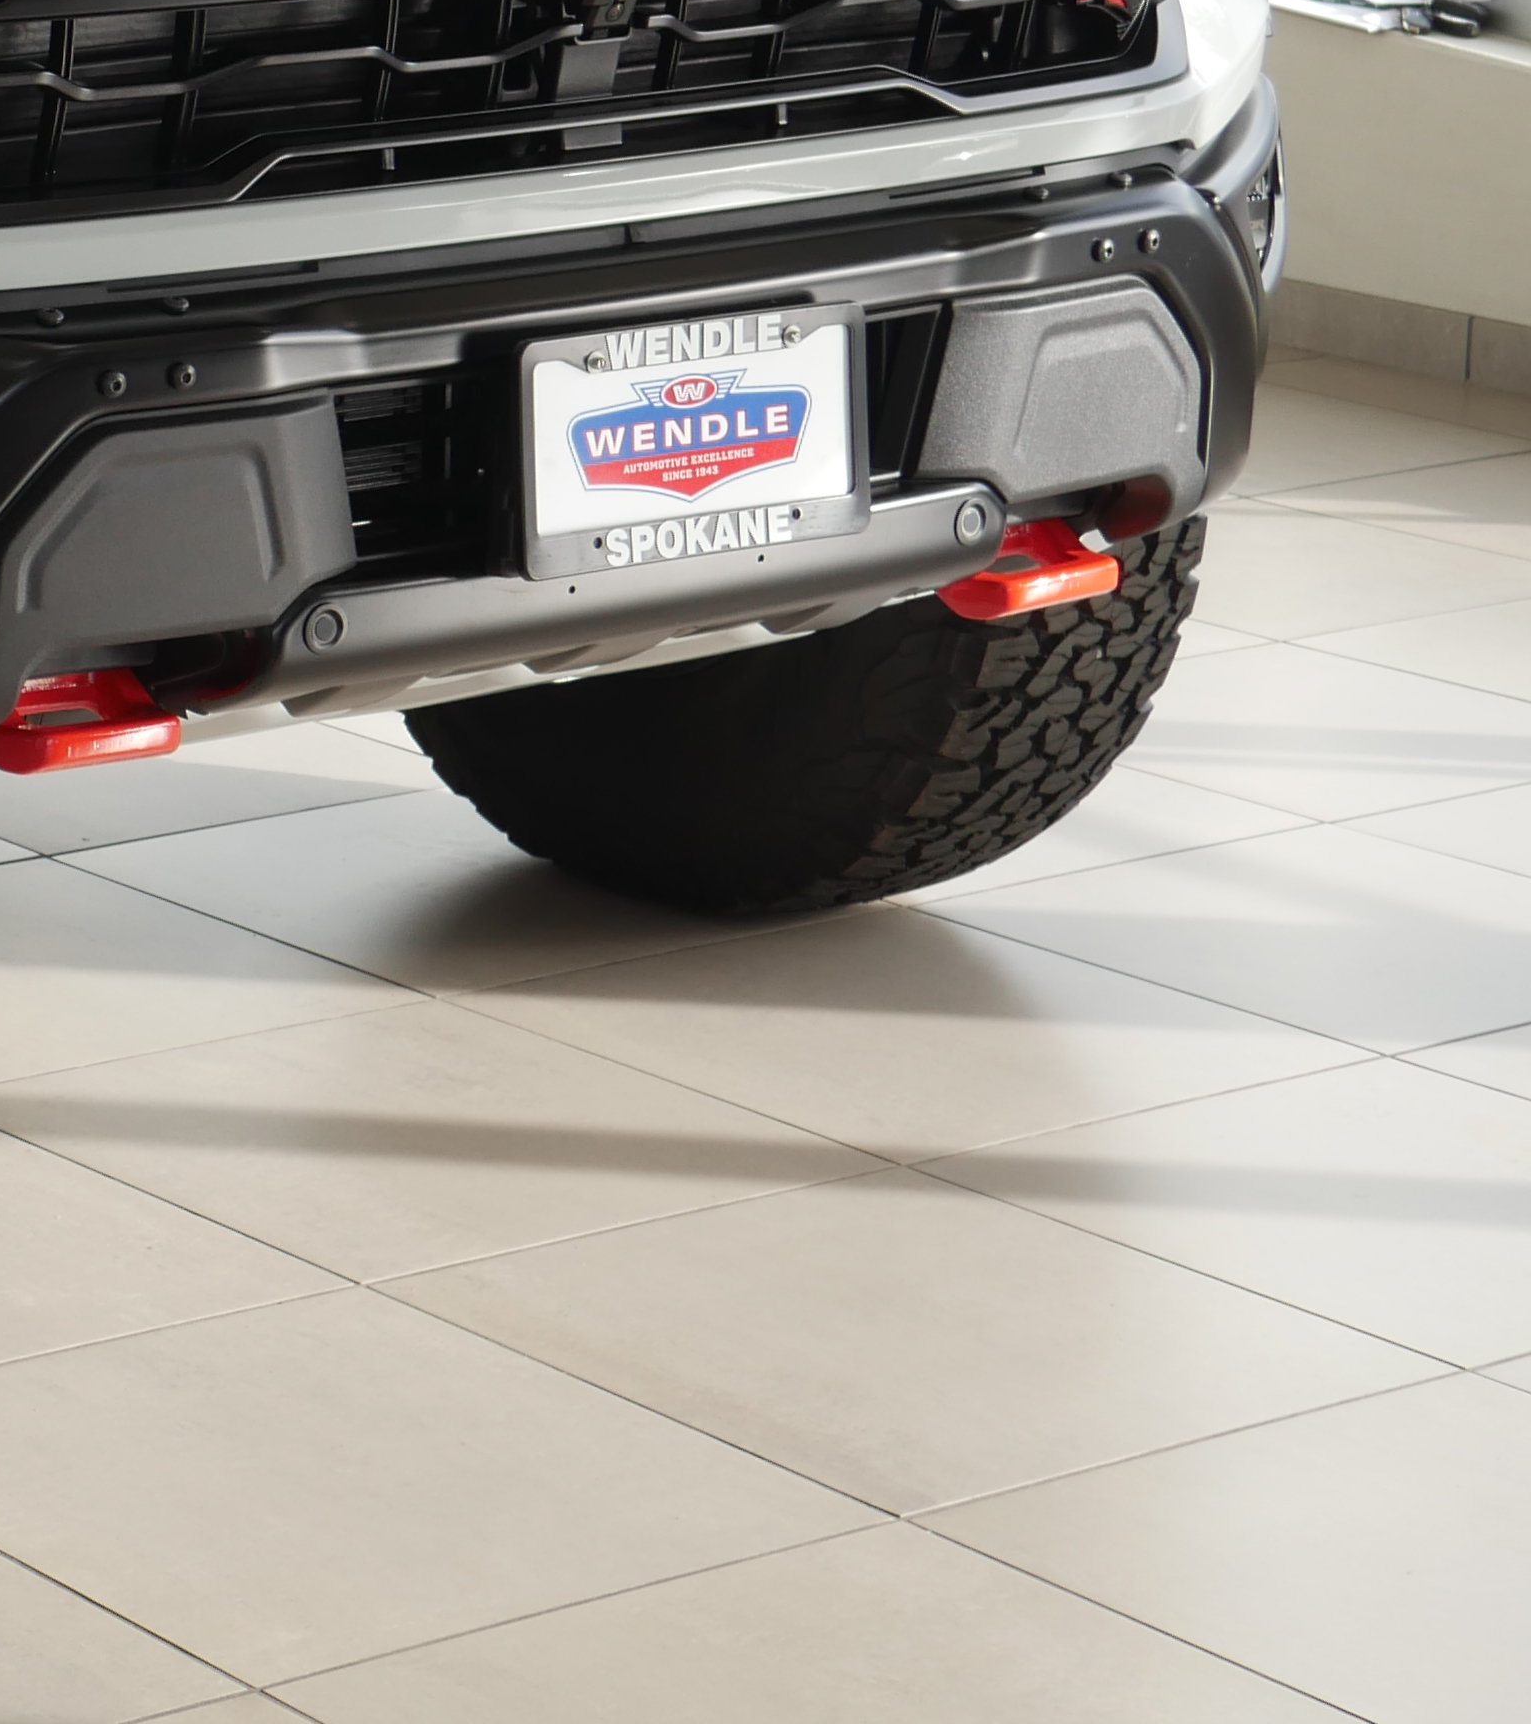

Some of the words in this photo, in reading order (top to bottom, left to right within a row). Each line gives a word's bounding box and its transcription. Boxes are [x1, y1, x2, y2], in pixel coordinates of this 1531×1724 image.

[606, 314, 782, 369] WENDLE
[585, 403, 790, 458] WENDLE
[623, 456, 688, 475] AUTOMOTIVE
[691, 447, 755, 466] EXCELLENCE
[662, 469, 693, 483] SINCE
[695, 465, 720, 479] 1943
[606, 504, 792, 567] SPOKANE
